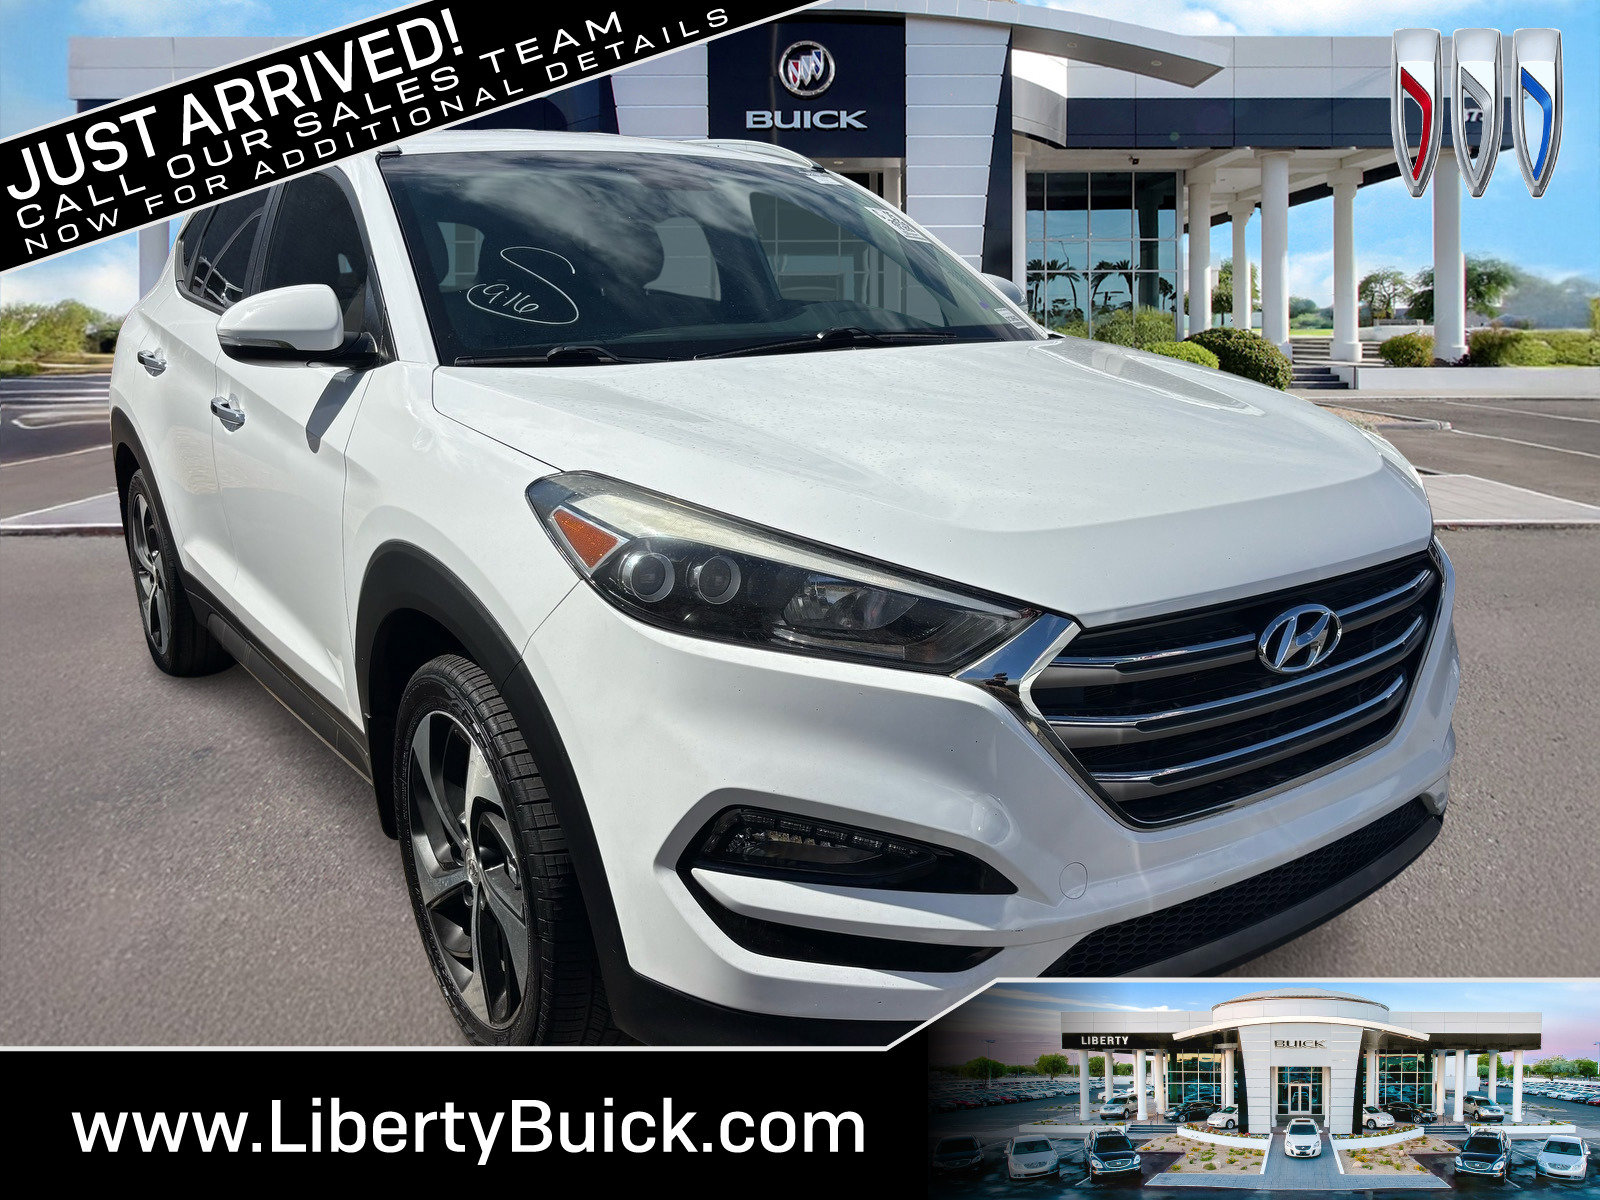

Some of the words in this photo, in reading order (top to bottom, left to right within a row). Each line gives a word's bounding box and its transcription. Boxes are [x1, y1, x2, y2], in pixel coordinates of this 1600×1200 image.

[746, 110, 868, 129] BUICK
[1081, 1035, 1129, 1046] LIBERTY
[1274, 1039, 1327, 1049] BUICK
